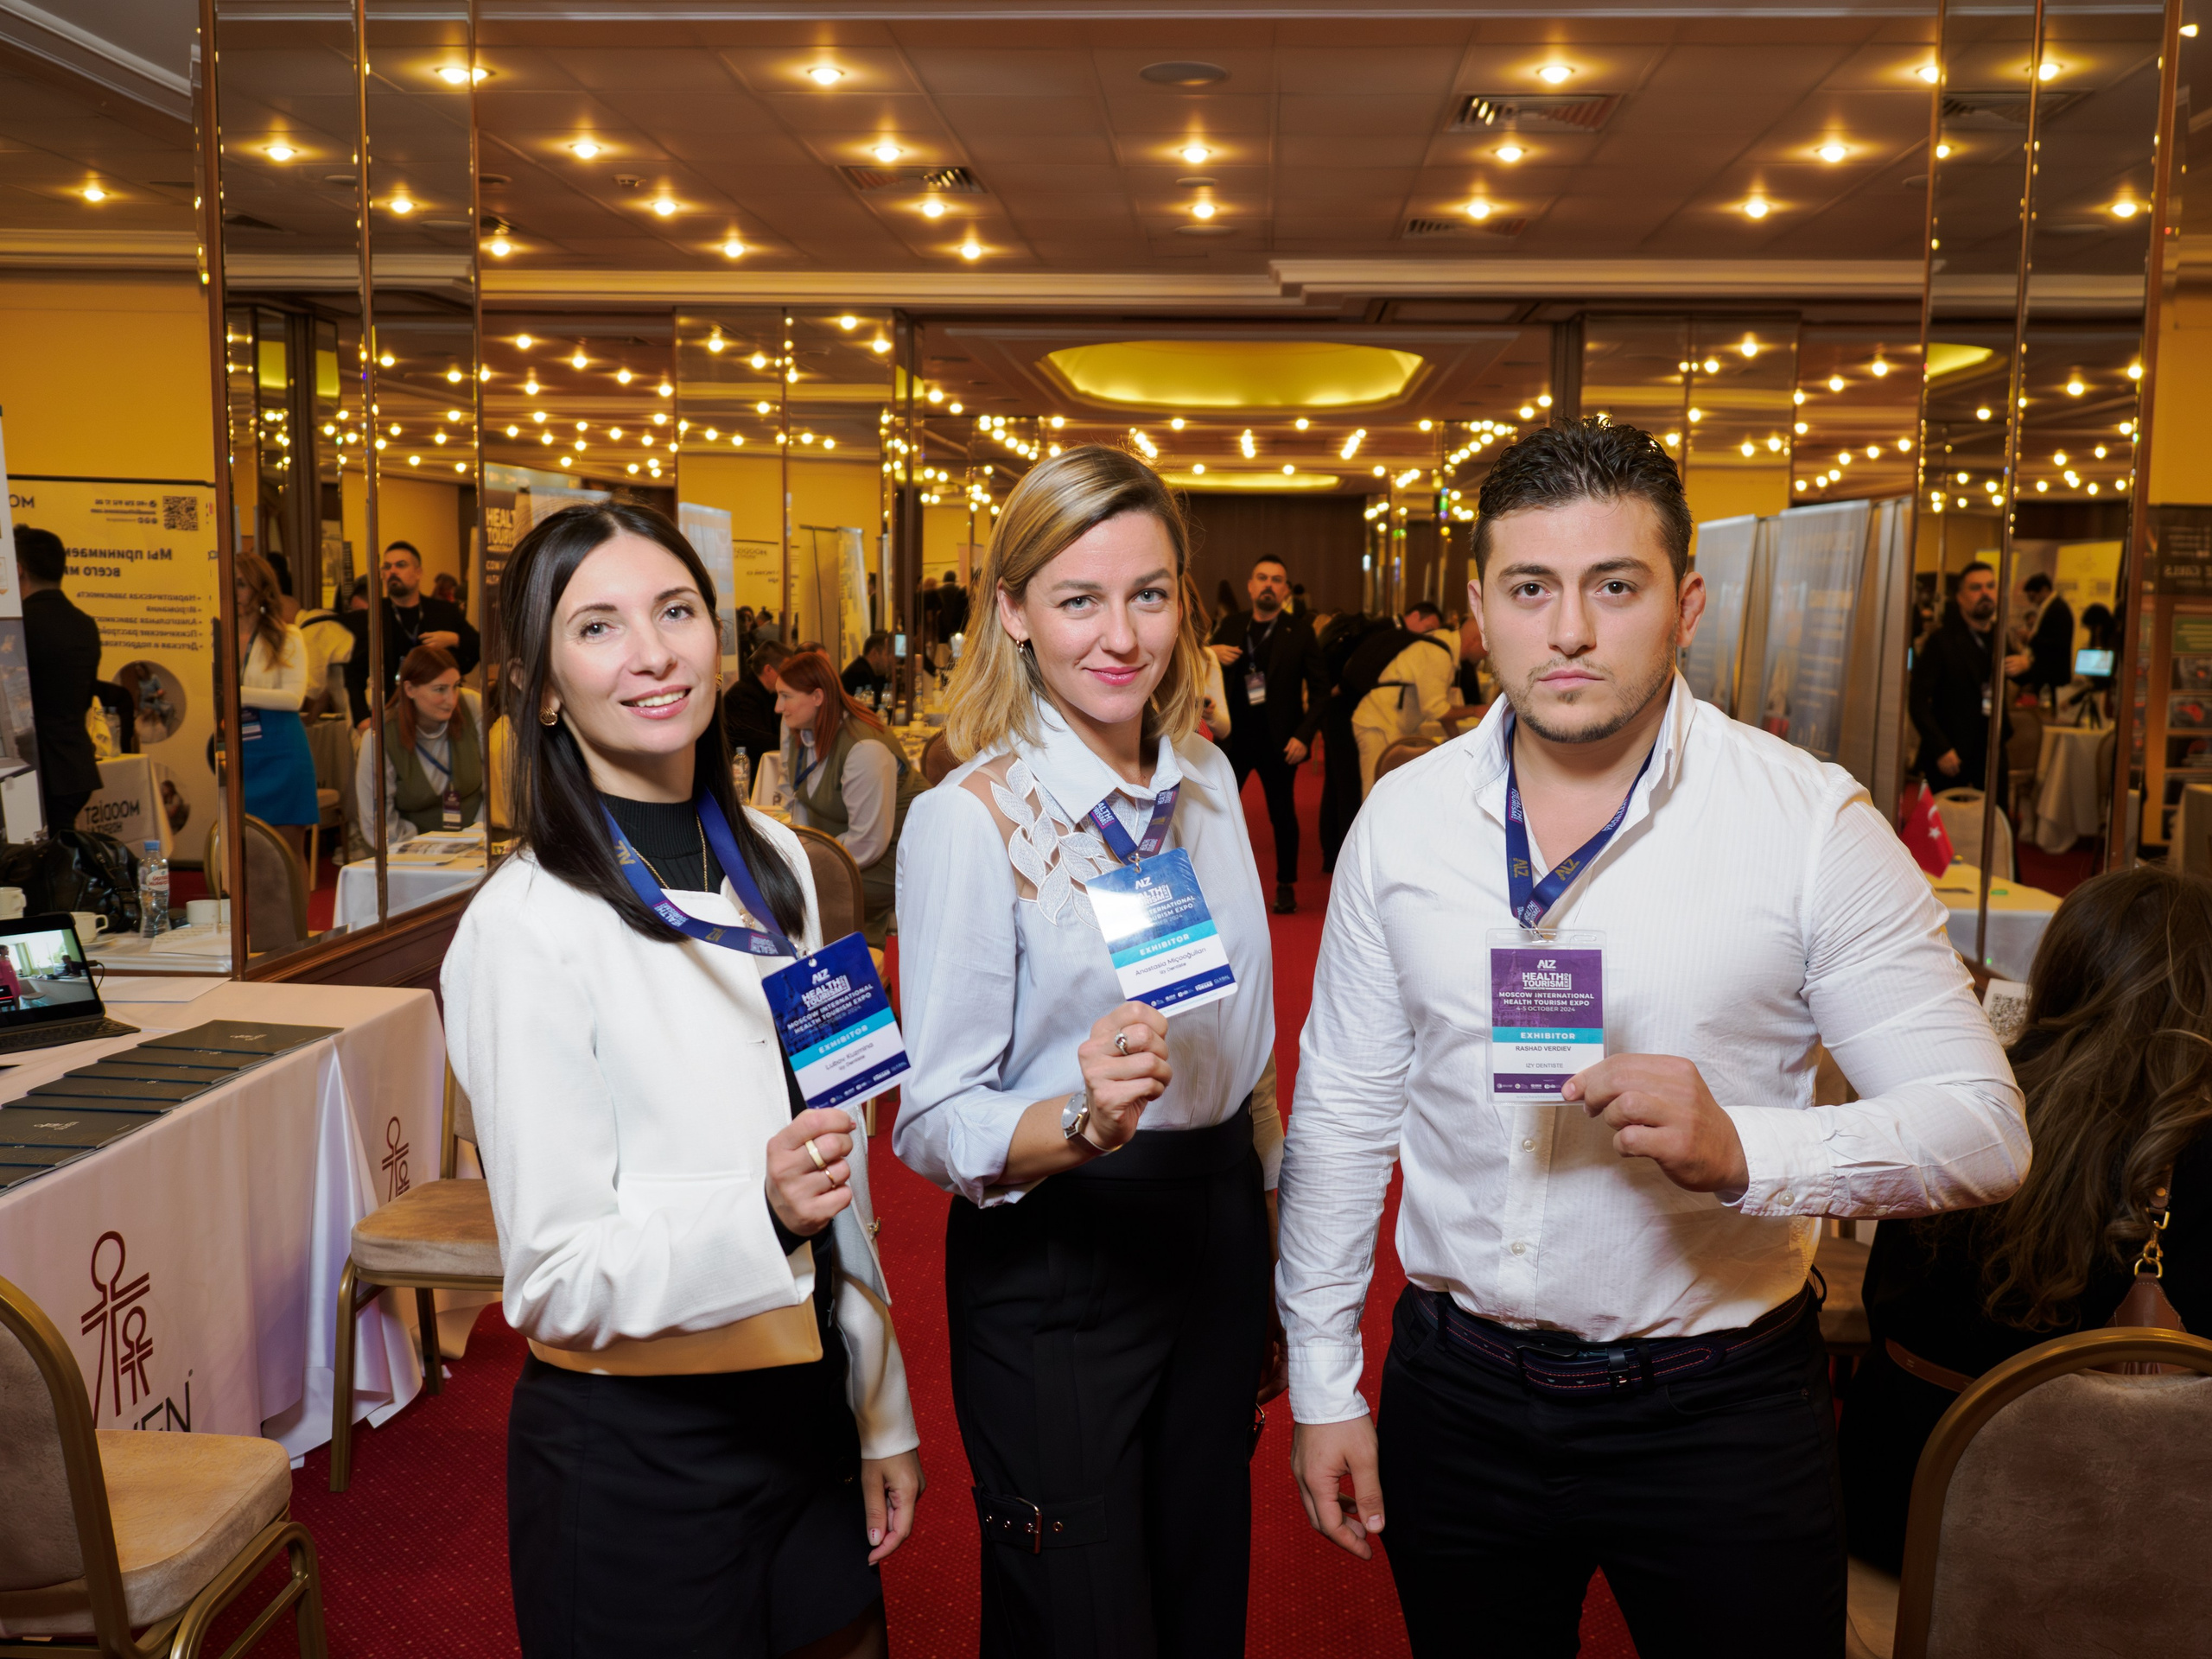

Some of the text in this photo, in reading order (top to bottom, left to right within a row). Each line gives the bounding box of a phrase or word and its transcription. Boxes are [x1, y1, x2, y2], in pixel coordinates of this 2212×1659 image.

[486, 507, 516, 528] HEALT
[1555, 858, 1580, 881] ALZ
[1135, 876, 1153, 890] ALZ
[1137, 885, 1162, 899] ALTH
[1144, 893, 1166, 906] RISM
[1147, 895, 1196, 914] TERNATIONAL
[655, 906, 683, 927] HEALTH
[1149, 903, 1193, 921] OURISM EXPO
[1139, 933, 1190, 955] EXHIBITOR
[1135, 961, 1167, 976] Anastasia
[1537, 959, 1556, 969] ALZ
[812, 968, 830, 984] ALZ
[801, 977, 842, 1001] HEALTH
[804, 985, 844, 1008] TOURISM
[787, 983, 874, 1030] MOSCOW INTERNATIONAL
[794, 1017, 822, 1034] HEALTH
[822, 1001, 853, 1020] TOURISM
[853, 992, 872, 1005] EXPO
[818, 1024, 868, 1054] EXHIBITOR
[825, 1057, 845, 1071] Lubov
